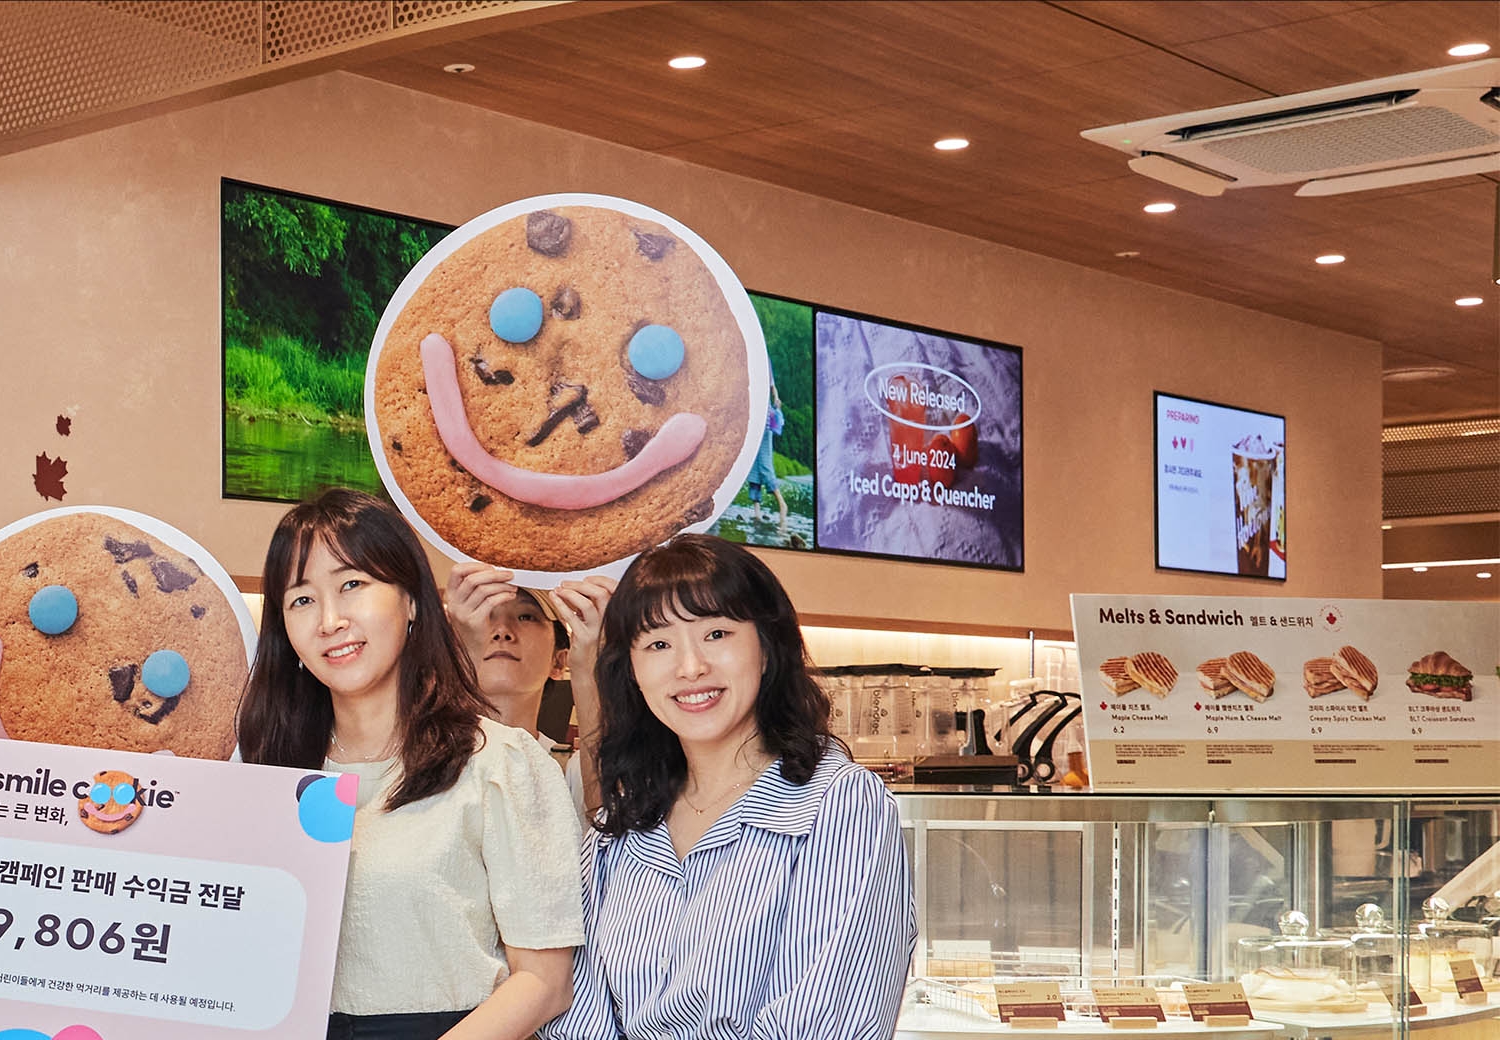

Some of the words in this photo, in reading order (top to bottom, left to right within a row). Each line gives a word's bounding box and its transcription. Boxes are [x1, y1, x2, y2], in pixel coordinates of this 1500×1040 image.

[878, 378, 907, 403] New
[910, 382, 966, 413] Released
[901, 445, 928, 468] June
[929, 449, 956, 470] 2024
[850, 469, 879, 495] Iced
[921, 480, 932, 502] &
[933, 481, 996, 510] Quencher
[1099, 607, 1145, 624] Melts
[1149, 608, 1161, 624] &
[1164, 609, 1244, 626] Sandwich
[1249, 615, 1267, 627] 멜트
[1270, 616, 1278, 626] &
[1279, 616, 1314, 627] 샌드위치
[1111, 714, 1131, 722] Maple
[1205, 714, 1224, 722] Maple
[1246, 714, 1268, 722] Cheese
[1309, 715, 1332, 724] Creamy
[1333, 715, 1348, 724] Spicy
[1113, 726, 1125, 734] 6.2
[1207, 726, 1219, 734] 6.9
[1310, 726, 1323, 735] 6.9
[1411, 727, 1423, 735] 6.9
[14, 803, 30, 821] 큰
[34, 806, 70, 827] 변화,
[70, 868, 118, 897] 판매
[122, 874, 192, 905] 수익금
[197, 881, 246, 911] 전달
[47, 979, 74, 992] 건강한
[75, 982, 110, 997] 먹거리를
[112, 988, 147, 1002] 제공하는
[148, 992, 159, 1003] 데
[160, 994, 188, 1006] 사용될
[188, 998, 236, 1013] 예정입니다.
